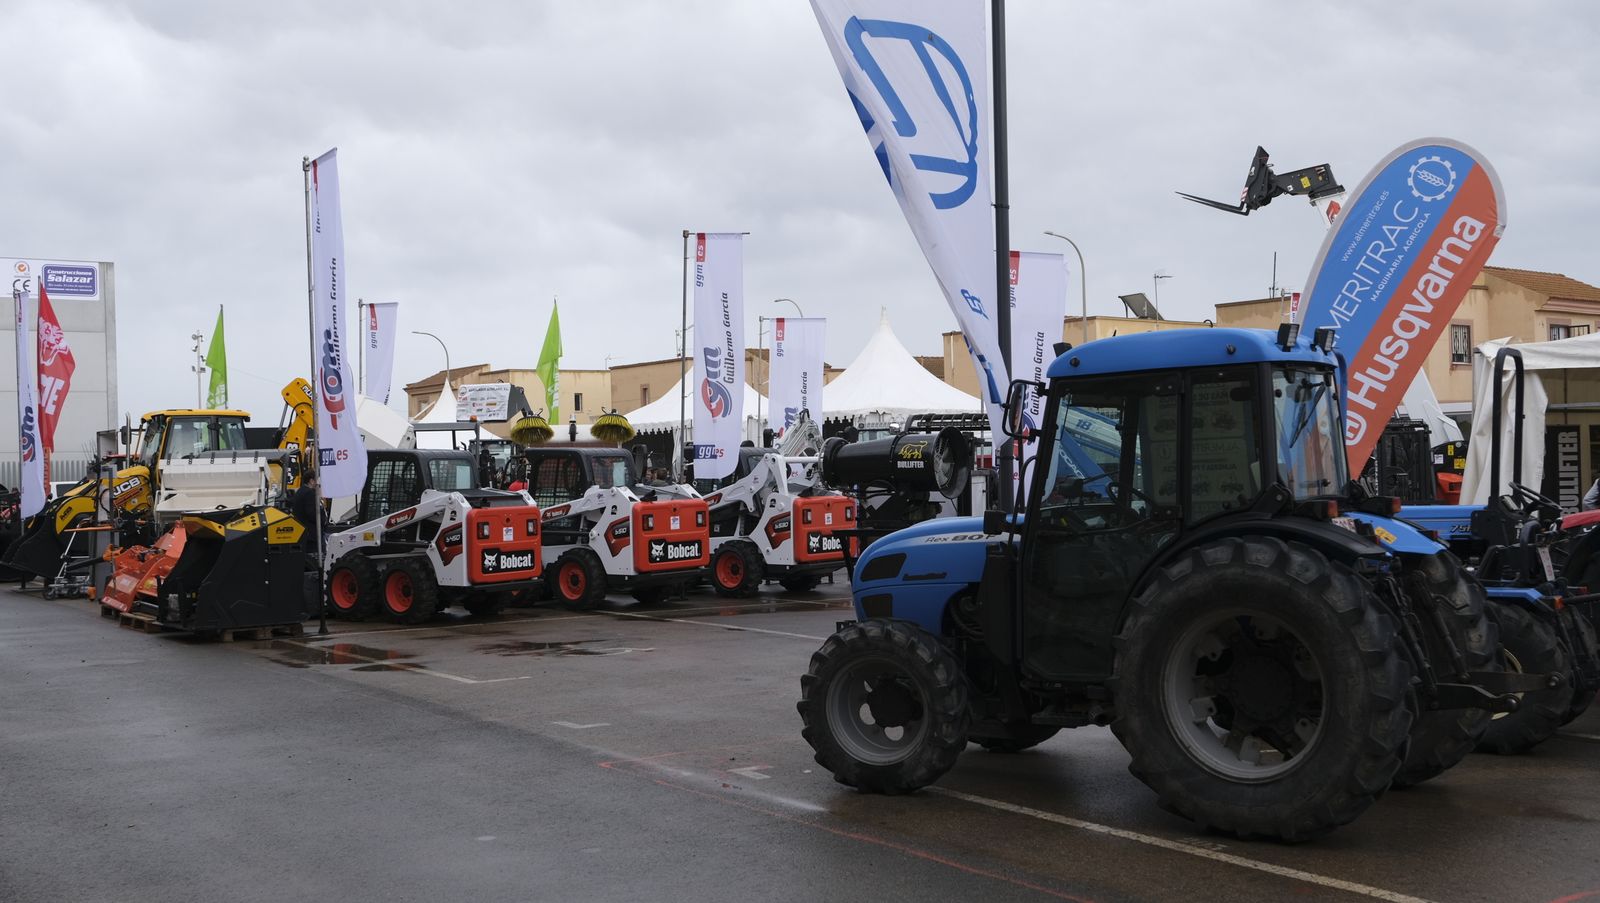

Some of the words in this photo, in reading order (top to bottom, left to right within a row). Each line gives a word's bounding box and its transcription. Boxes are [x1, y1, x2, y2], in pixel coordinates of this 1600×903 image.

[1341, 190, 1389, 262] www.almeritrac.es
[47, 268, 92, 276] Construcciones
[1318, 200, 1418, 338] MERITRAC
[1371, 254, 1404, 302] MAQUINARIA
[1404, 212, 1431, 252] AGRICOLA
[47, 274, 93, 284] Salazar
[721, 292, 732, 328] García
[1352, 215, 1486, 410] Husqvarna
[723, 330, 734, 384] Guillermo
[1034, 332, 1044, 364] García
[1030, 366, 1042, 415] Guillemo
[113, 477, 141, 496] JCB
[1558, 431, 1579, 518] BULLIFTER
[667, 543, 699, 559] Bobcat
[822, 536, 842, 551] Bobc
[925, 535, 950, 543] Rex
[501, 553, 532, 569] Bobcat
